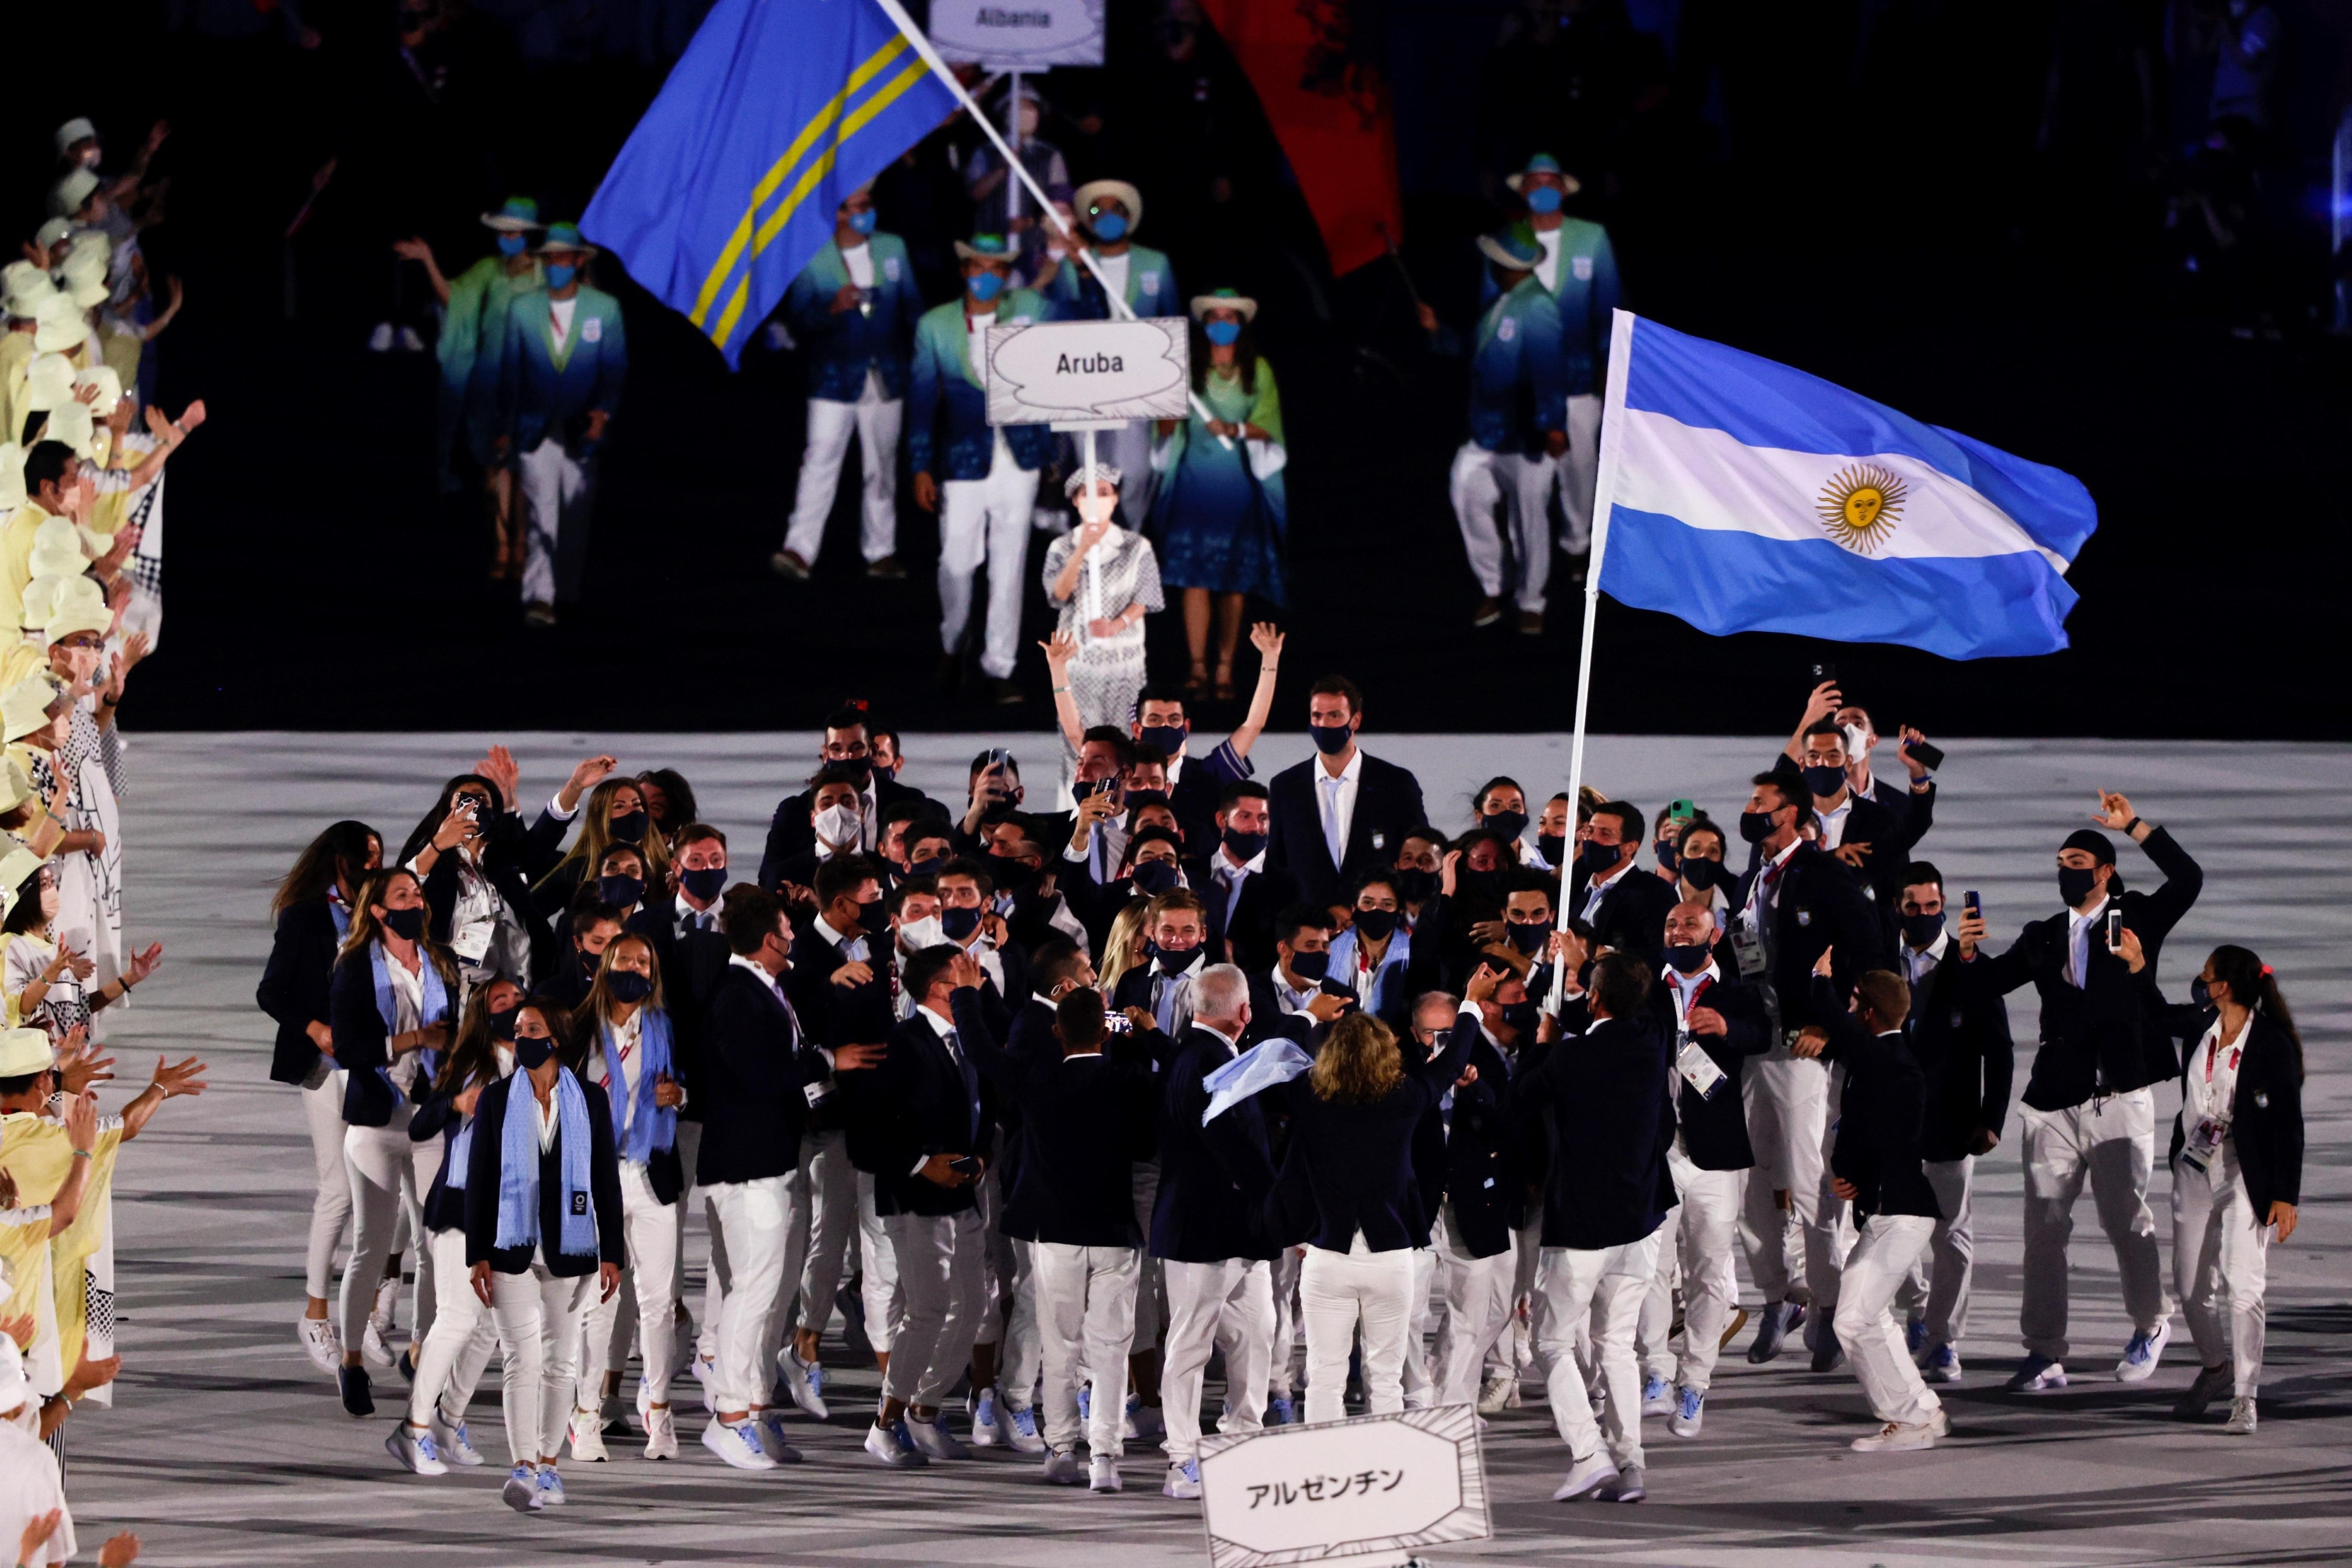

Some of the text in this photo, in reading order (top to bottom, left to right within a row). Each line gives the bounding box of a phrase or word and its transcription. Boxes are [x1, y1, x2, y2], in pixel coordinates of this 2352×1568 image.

[976, 7, 1050, 27] Albania
[1056, 352, 1123, 374] Aruba
[1247, 1470, 1403, 1509] アルゼンチン
